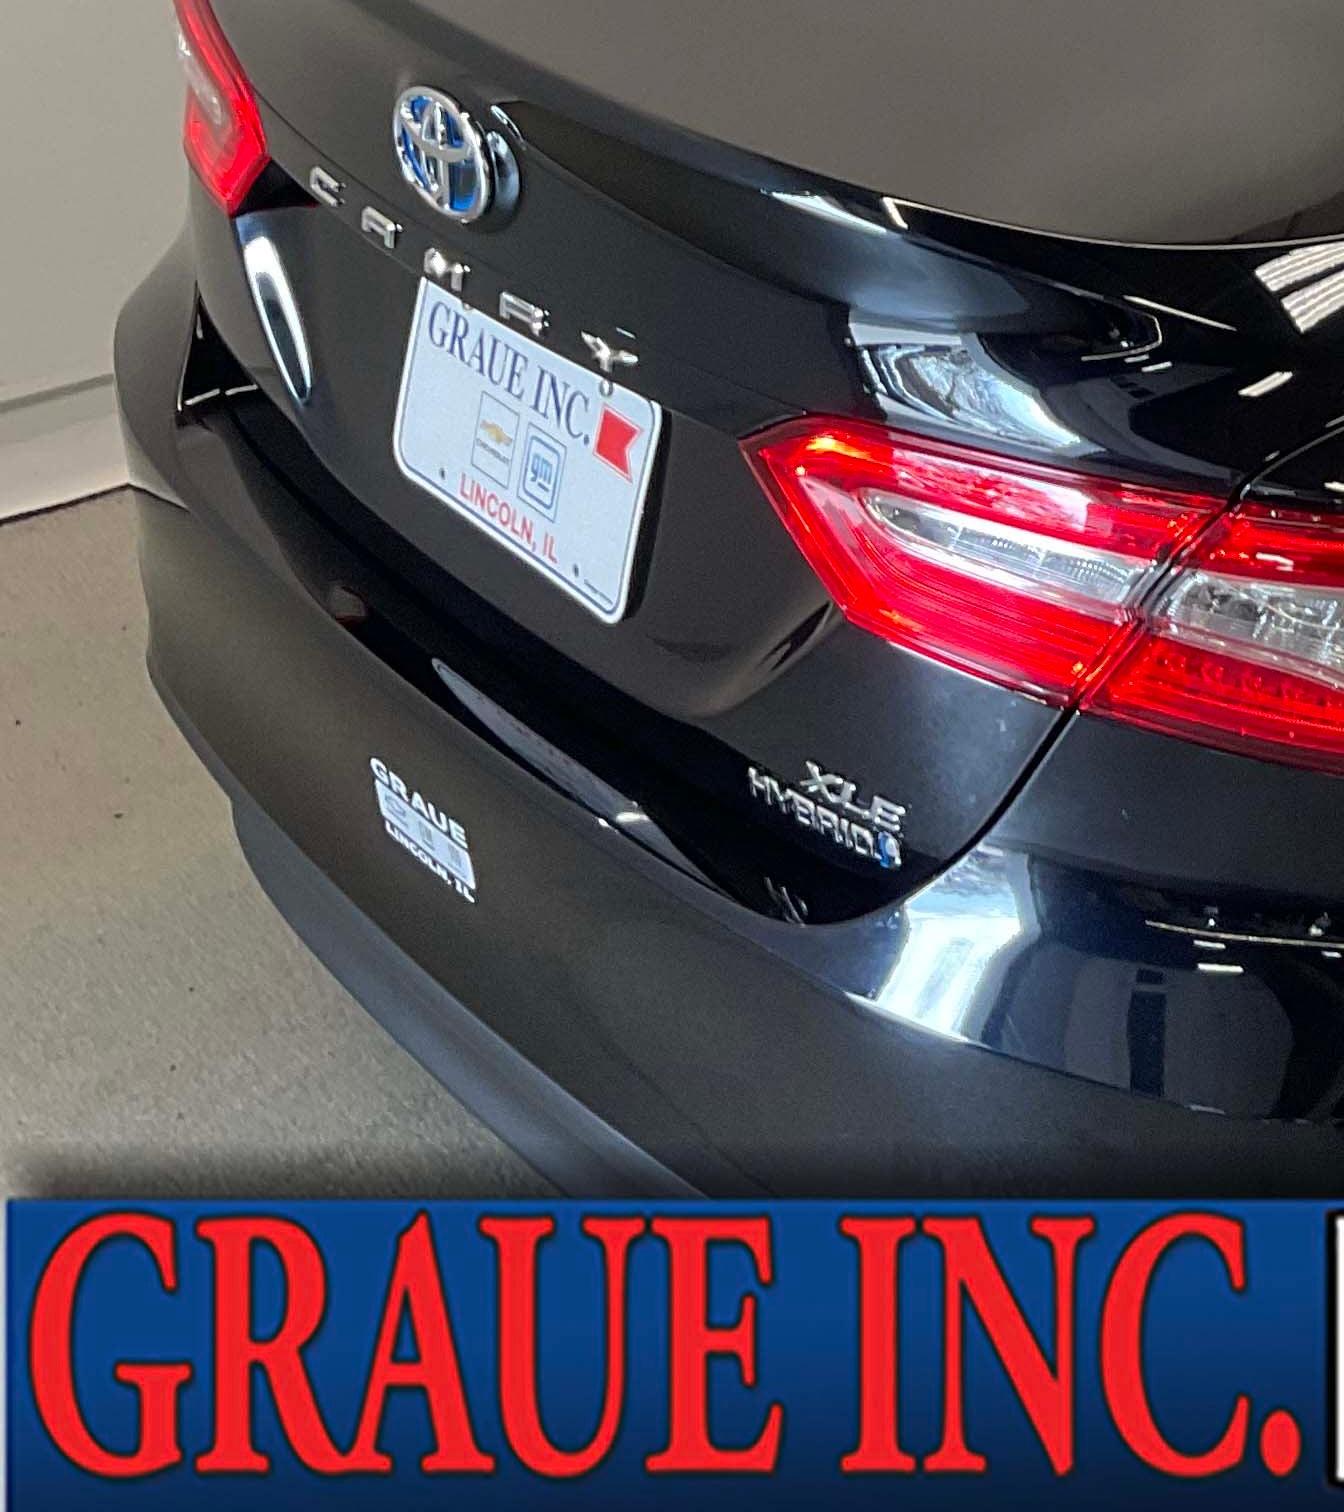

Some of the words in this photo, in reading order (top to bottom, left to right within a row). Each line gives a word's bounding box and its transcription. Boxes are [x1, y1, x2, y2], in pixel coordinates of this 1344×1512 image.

[309, 165, 639, 373] CAMRY
[428, 300, 528, 399] GRAUE
[529, 364, 591, 446] INC.
[459, 472, 537, 552] LINCOLN,
[542, 531, 558, 564] IL
[369, 756, 469, 850] GRAUE
[748, 766, 876, 859] HYBRID
[799, 760, 907, 832] XLE
